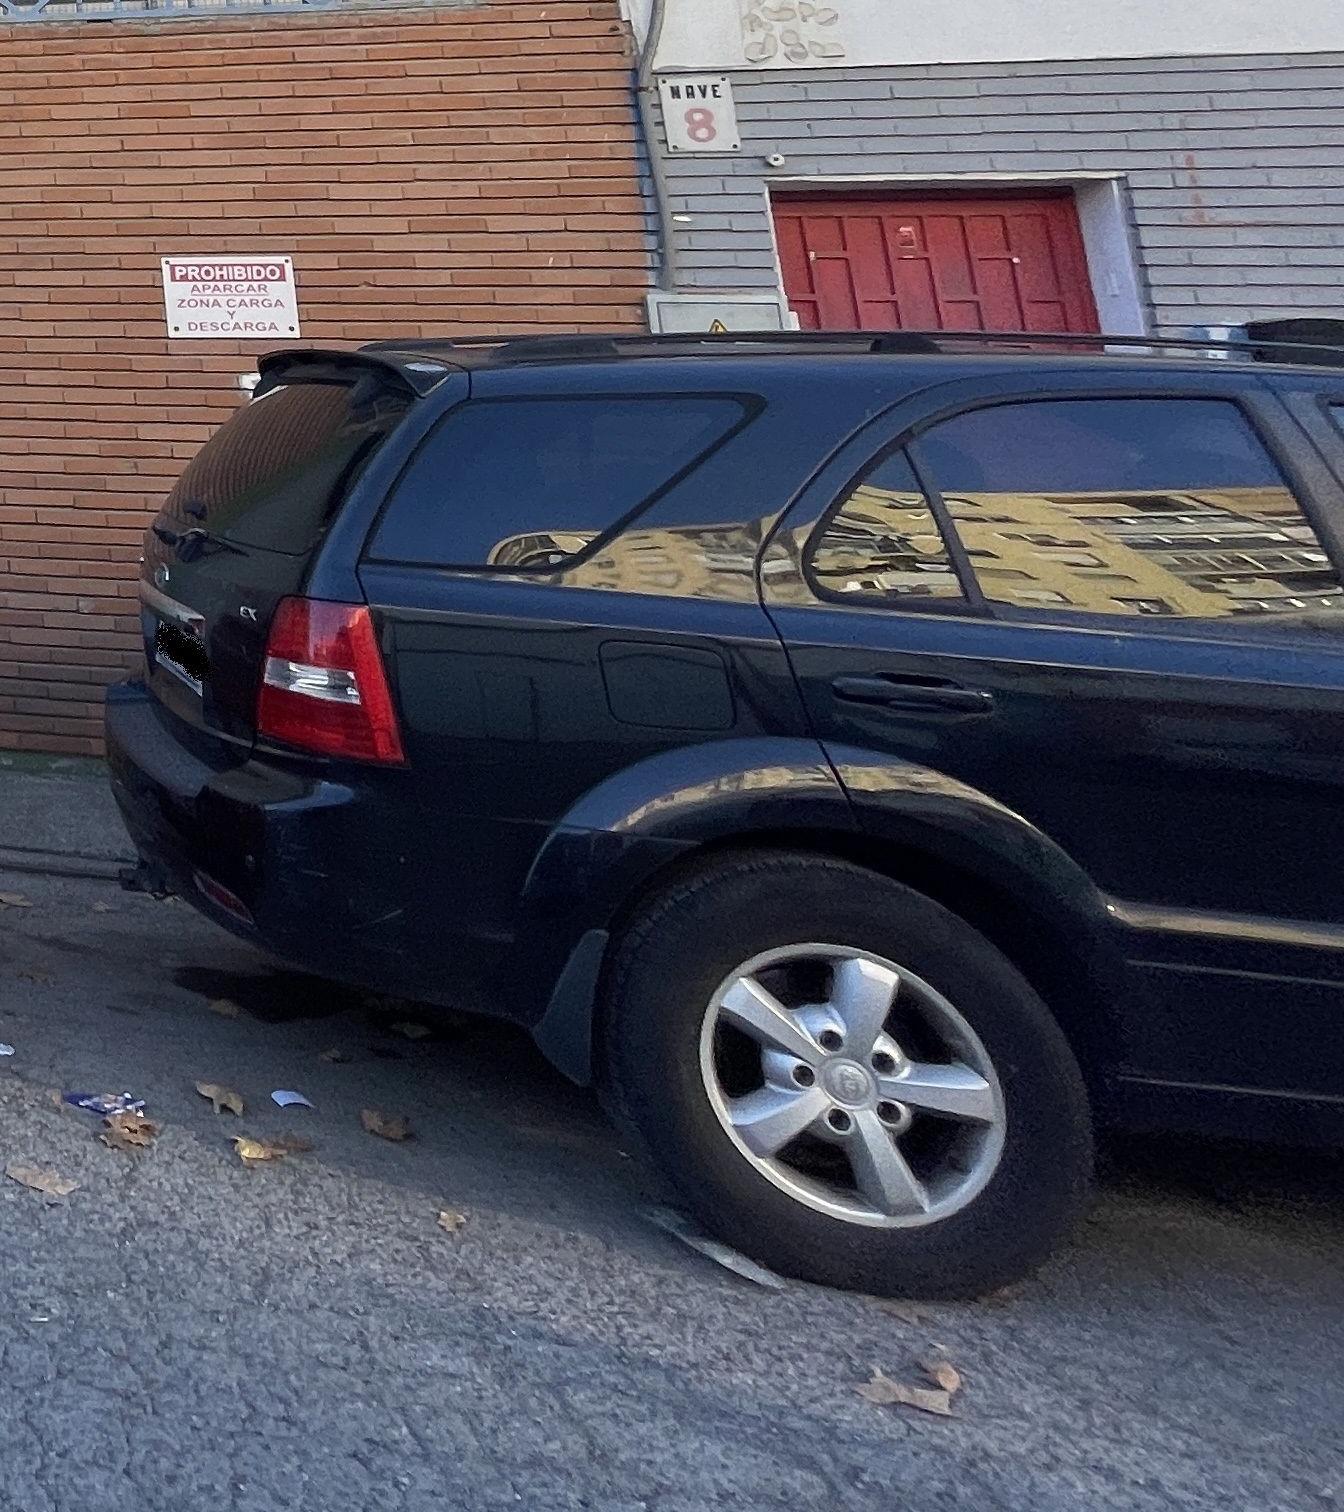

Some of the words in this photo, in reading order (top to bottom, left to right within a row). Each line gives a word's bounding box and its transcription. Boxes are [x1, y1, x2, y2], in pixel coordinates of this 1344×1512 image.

[669, 84, 722, 99] NAVE
[684, 107, 717, 143] 8
[174, 265, 281, 281] PROHIBIDO
[191, 283, 268, 293] APARCAR
[177, 299, 222, 308] ZONA
[226, 298, 285, 308] CARGA
[227, 310, 236, 320] Y
[188, 321, 279, 332] DESCARGA
